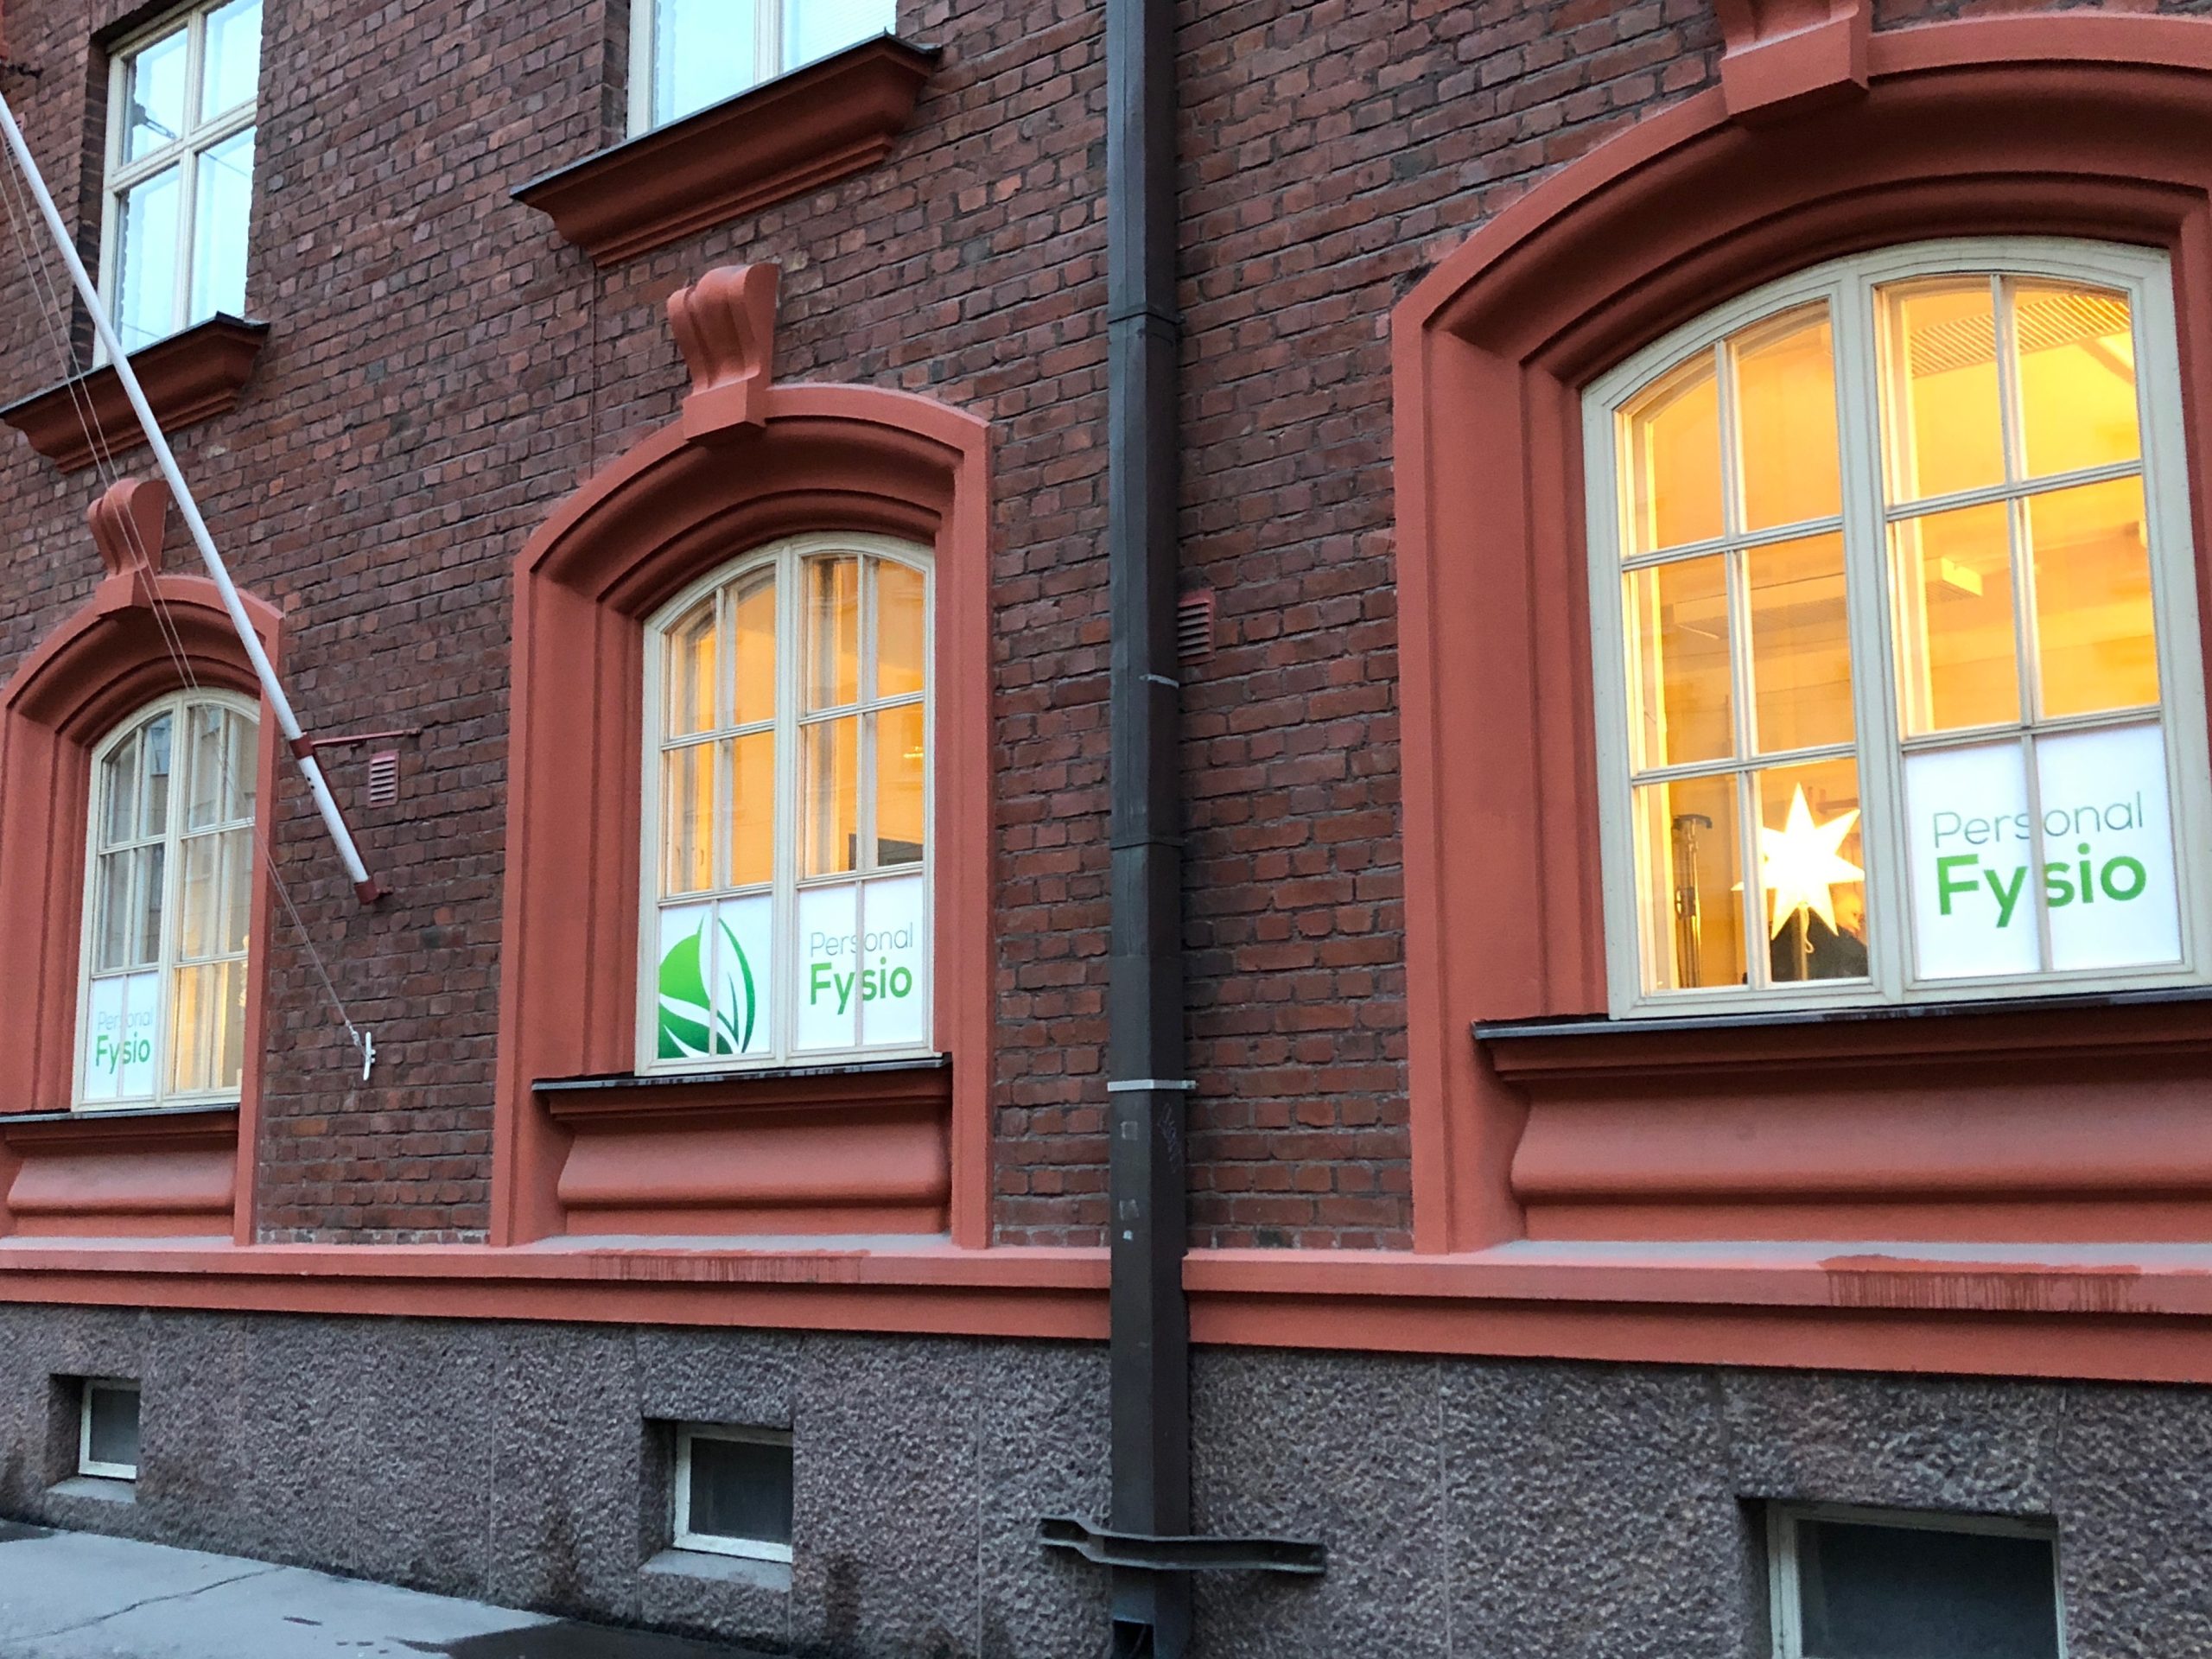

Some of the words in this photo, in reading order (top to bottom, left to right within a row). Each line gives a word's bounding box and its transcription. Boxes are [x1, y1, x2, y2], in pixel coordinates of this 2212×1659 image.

[1934, 791, 2143, 848] Personal
[1937, 842, 2146, 928] Fysio
[810, 957, 912, 1014] Fysio
[98, 1007, 154, 1030] Peronal
[96, 1032, 150, 1074] Fysio
